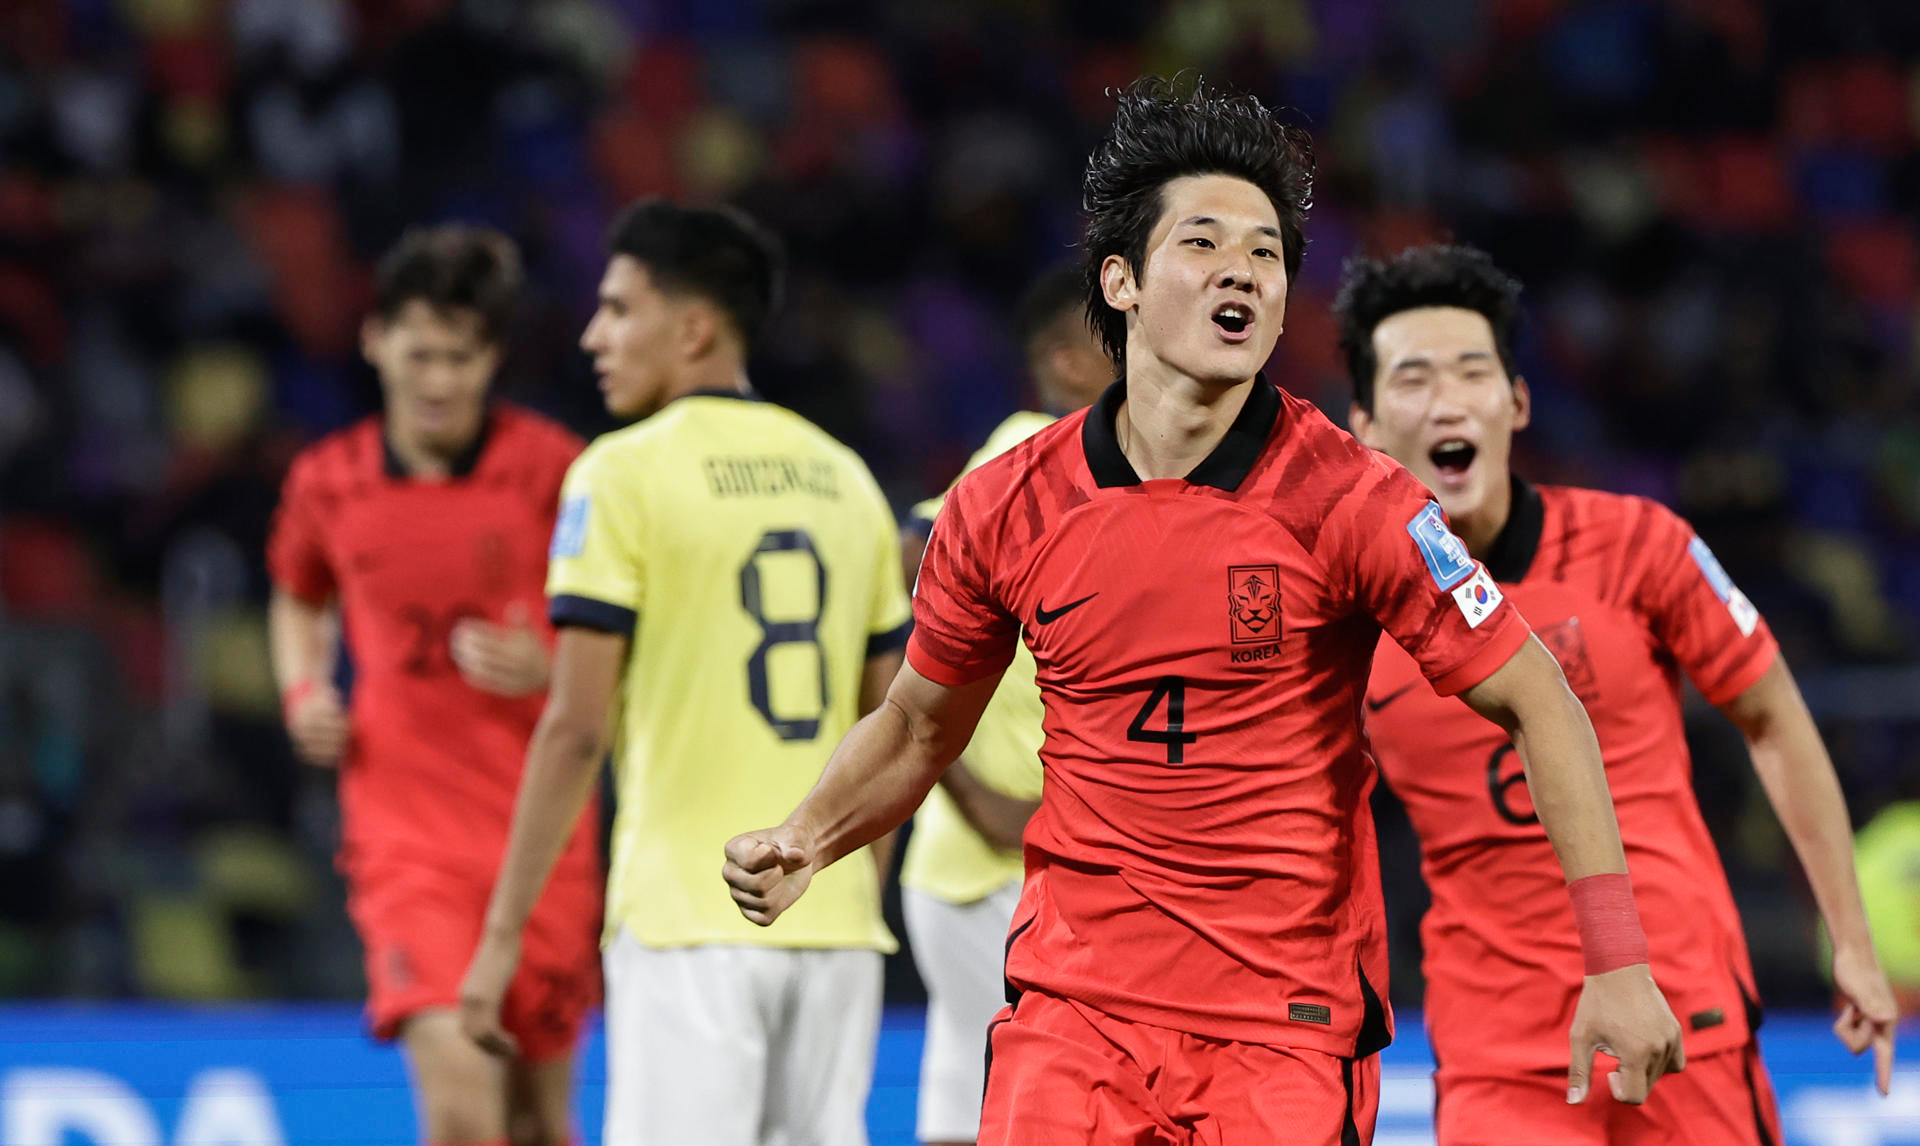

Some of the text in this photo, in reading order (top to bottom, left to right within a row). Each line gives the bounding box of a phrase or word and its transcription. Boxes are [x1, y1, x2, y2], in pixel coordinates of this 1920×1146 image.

[740, 529, 830, 740] 8
[1231, 644, 1282, 663] KOREA
[1127, 675, 1197, 764] 4
[1487, 741, 1540, 827] 6
